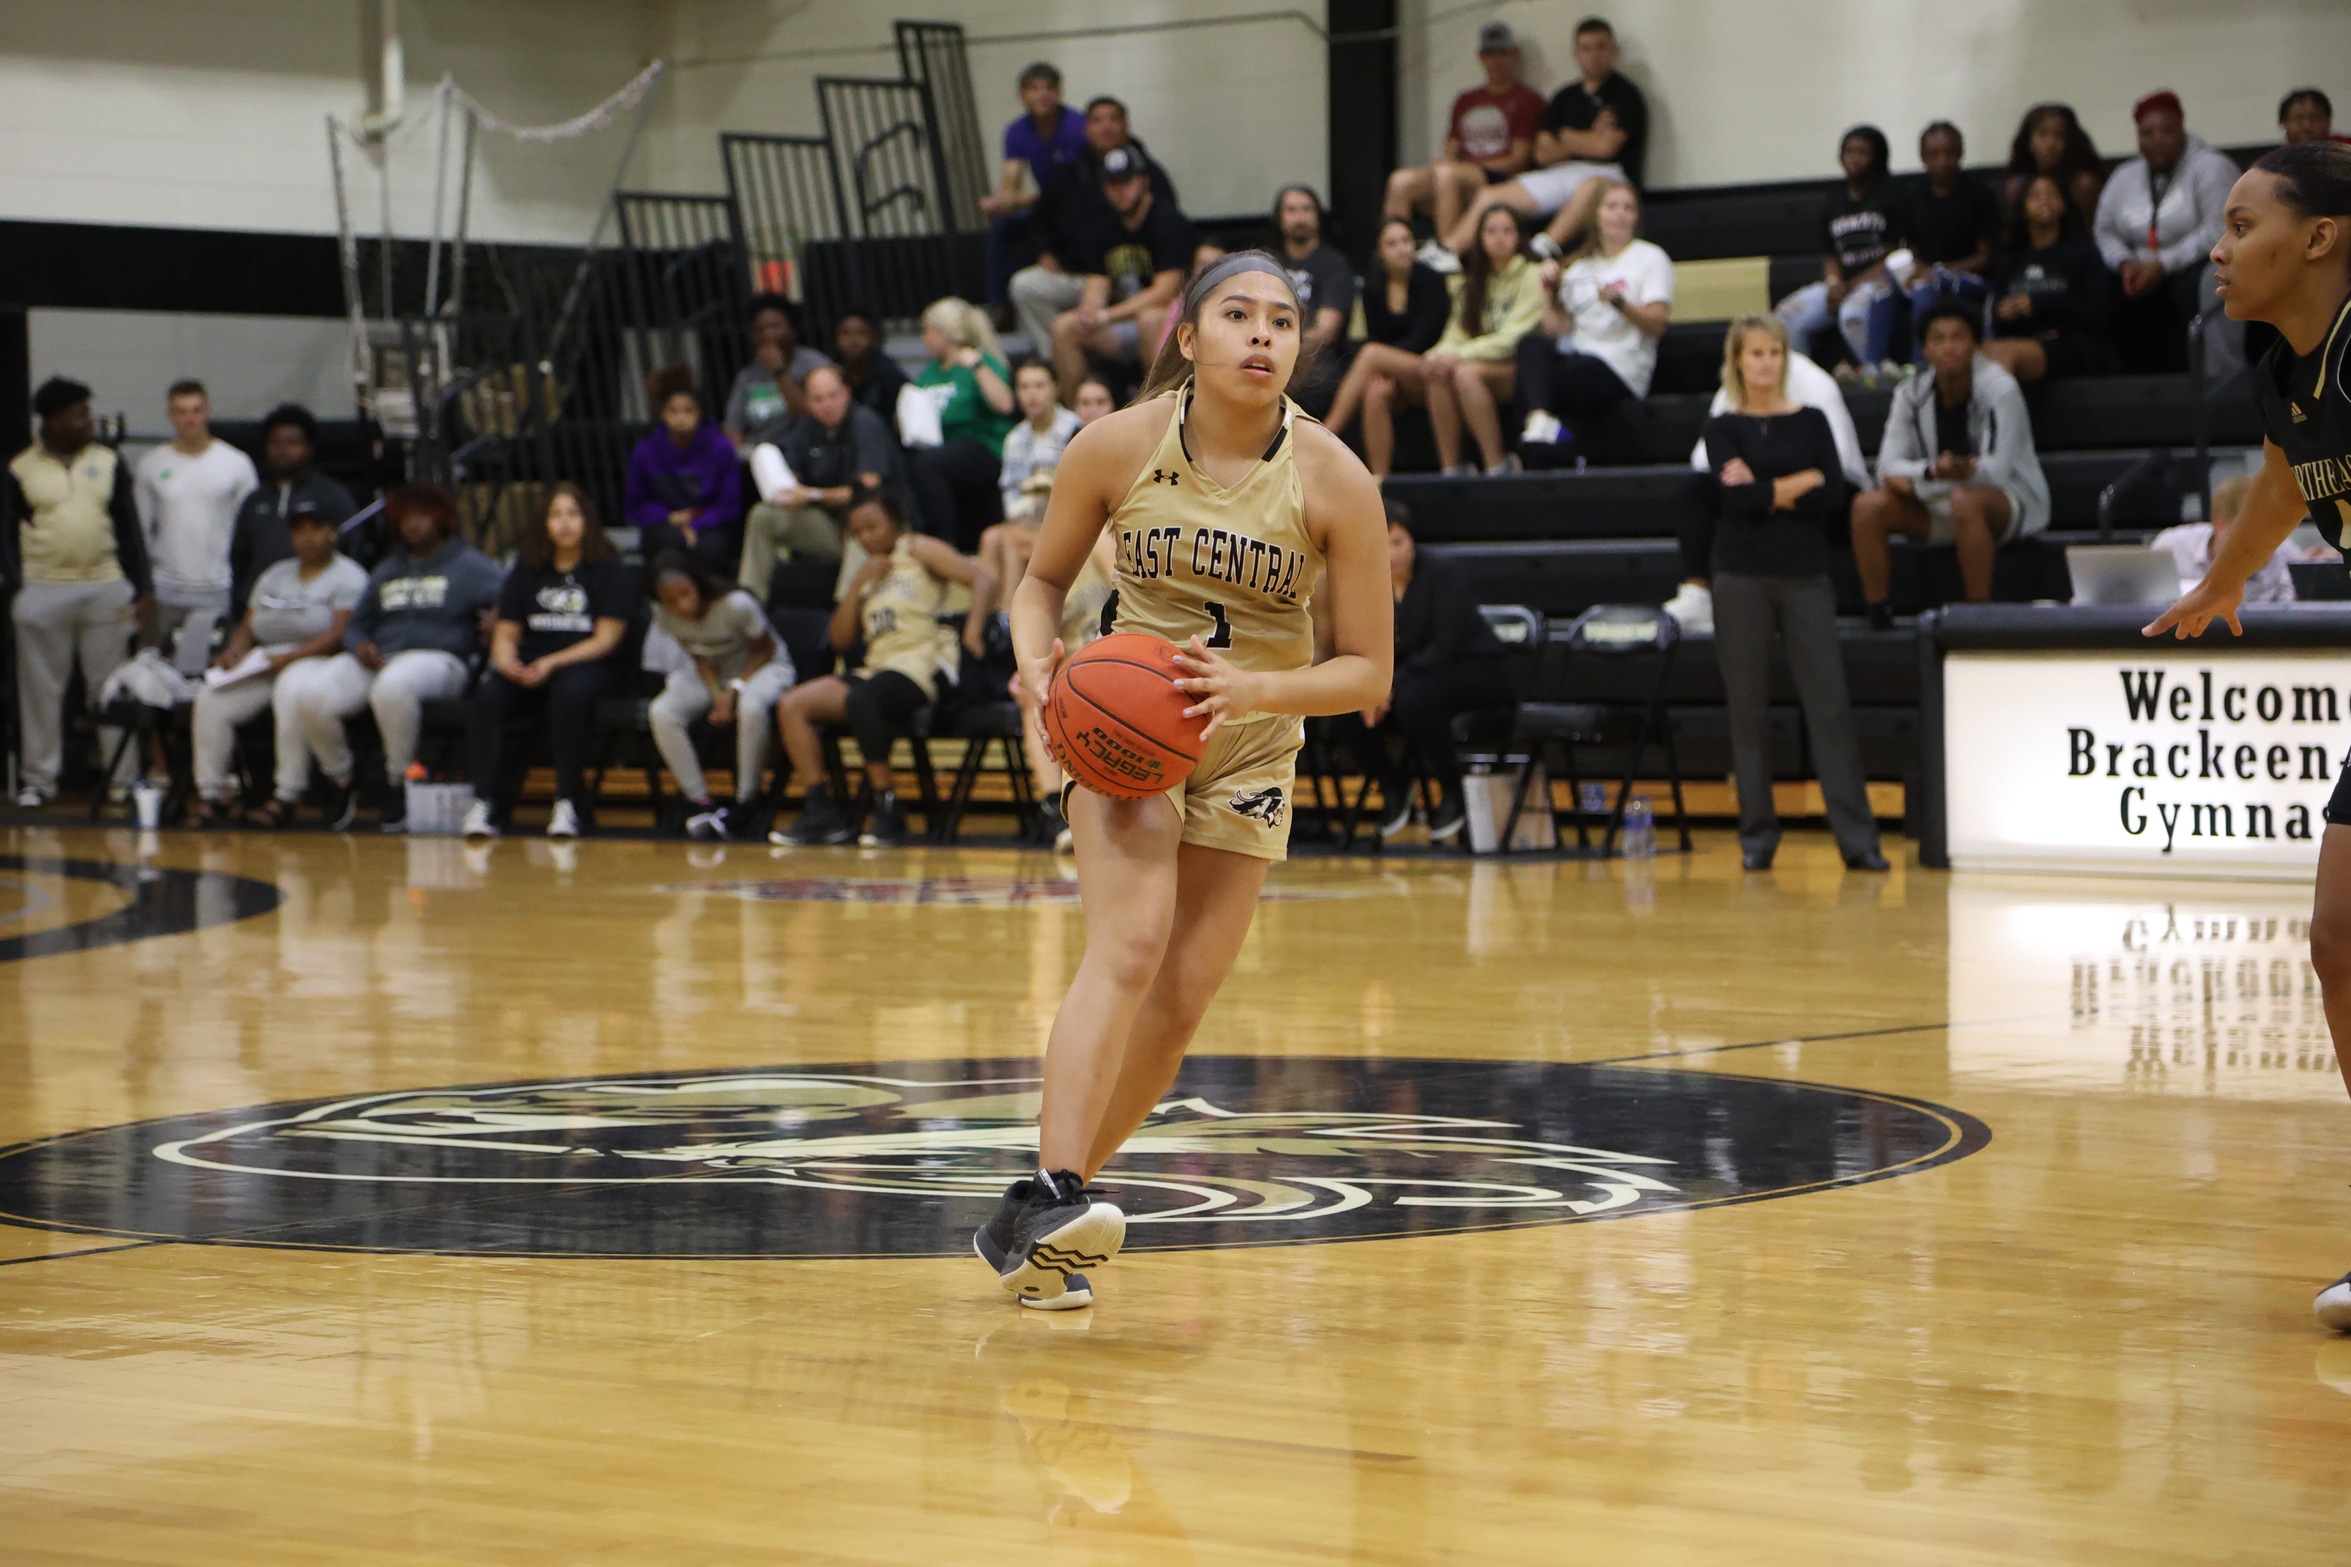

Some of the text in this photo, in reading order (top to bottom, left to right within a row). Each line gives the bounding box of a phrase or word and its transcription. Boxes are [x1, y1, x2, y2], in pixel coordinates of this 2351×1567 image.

[2291, 454, 2351, 501] RTHEA
[1123, 527, 1304, 599] EAST CENTRAL
[1203, 601, 1232, 649] 1
[2119, 671, 2351, 722] Welcom
[1076, 731, 1165, 784] LEGACY
[1093, 727, 1145, 763] 1000
[1056, 743, 1142, 800] ALDING
